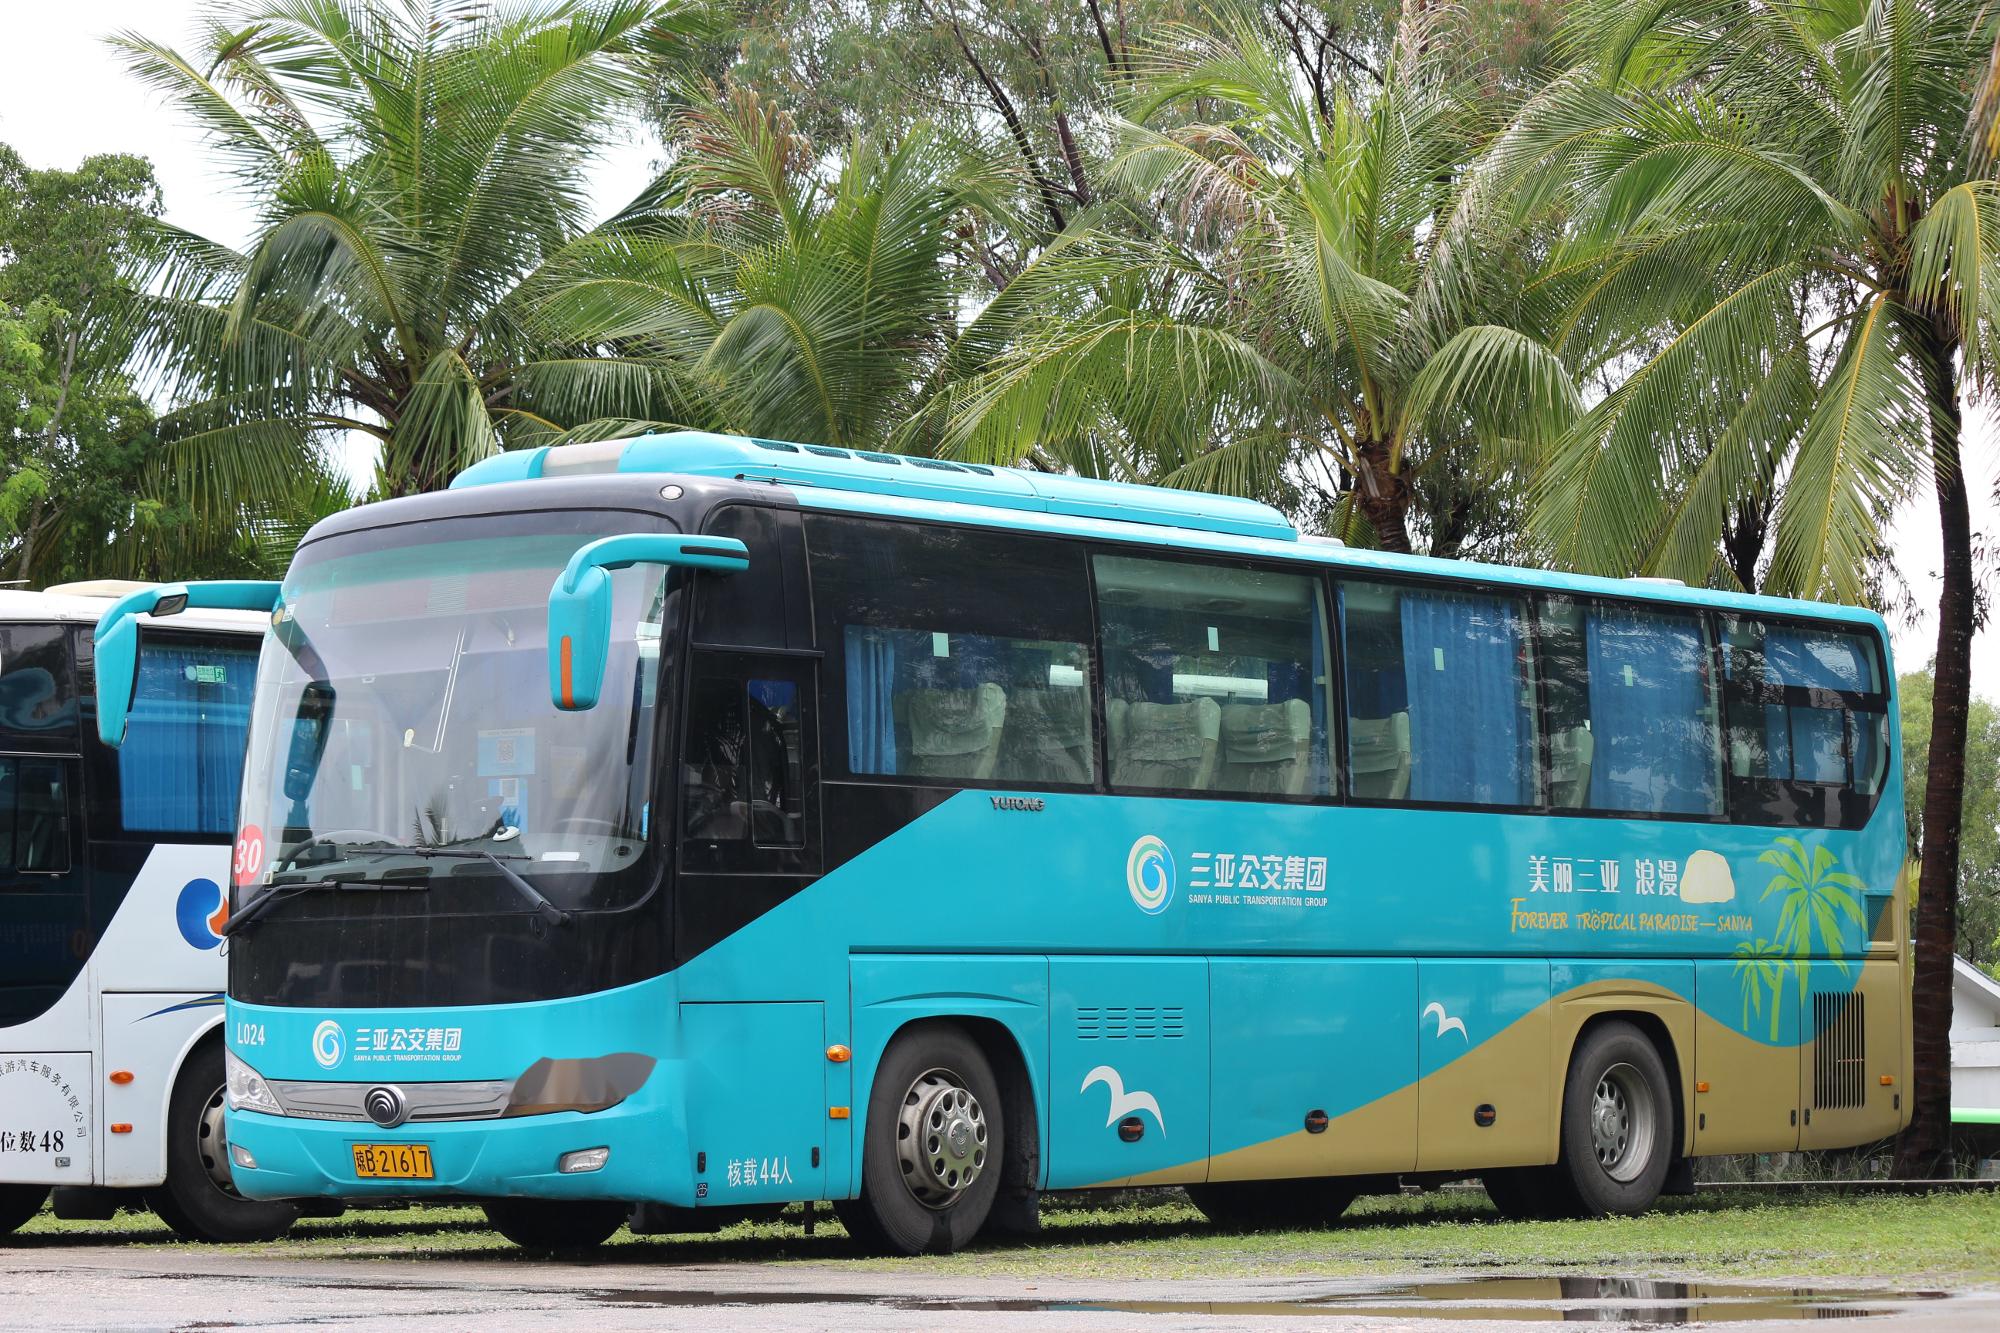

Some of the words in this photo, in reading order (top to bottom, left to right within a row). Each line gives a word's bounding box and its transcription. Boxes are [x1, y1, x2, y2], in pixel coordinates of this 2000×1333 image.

[989, 796, 1045, 812] YUTONG
[234, 838, 262, 874] 30
[1189, 852, 1328, 892] 三亚公交集团
[1528, 855, 1621, 893] 美丽三亚
[1635, 858, 1678, 897] 浪漫
[1188, 894, 1213, 904] SANYA
[1215, 895, 1240, 905] PUBLIC
[1243, 896, 1302, 907] TRANSPORTATION
[1305, 897, 1328, 907] GROUP
[1510, 897, 1569, 934] FOREVER
[237, 1022, 265, 1046] L024
[354, 1027, 463, 1052] 三亚公交集团
[372, 1054, 392, 1062] PUBLIC
[393, 1054, 441, 1062] TRANSPORTATION
[442, 1054, 462, 1062] GROUP
